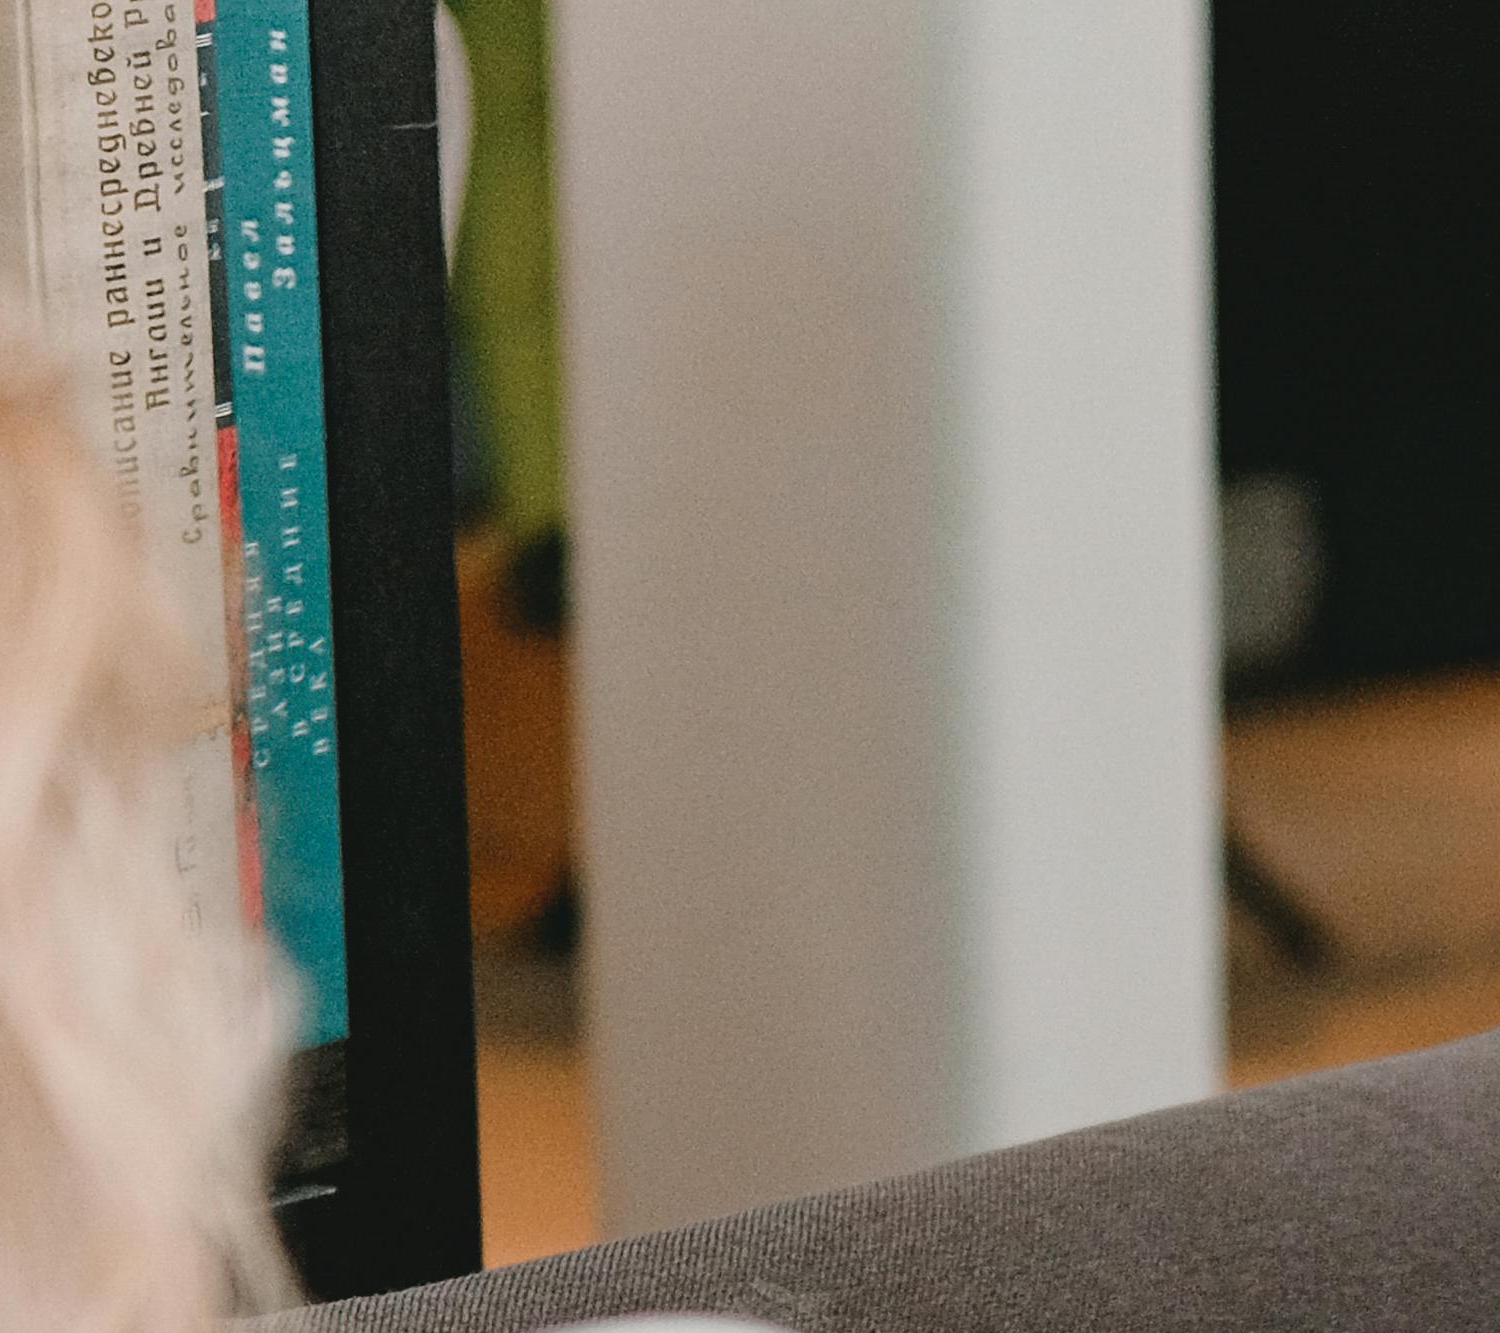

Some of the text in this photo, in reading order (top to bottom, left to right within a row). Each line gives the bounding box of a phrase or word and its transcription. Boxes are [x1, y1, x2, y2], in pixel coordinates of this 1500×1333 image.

[87, 0, 142, 525] описание раннесредневеко
[123, 0, 170, 410] Англии и Древней Р
[155, 0, 208, 544] Сравнительное исследова
[268, 29, 296, 289] Зальцман
[240, 219, 266, 374] Павел
[244, 541, 270, 768] СРЕДНЯЯ
[267, 595, 289, 717] АЗИЯ
[278, 452, 310, 737] В СРЕДНИЕ
[308, 636, 331, 756] ВЕКА
